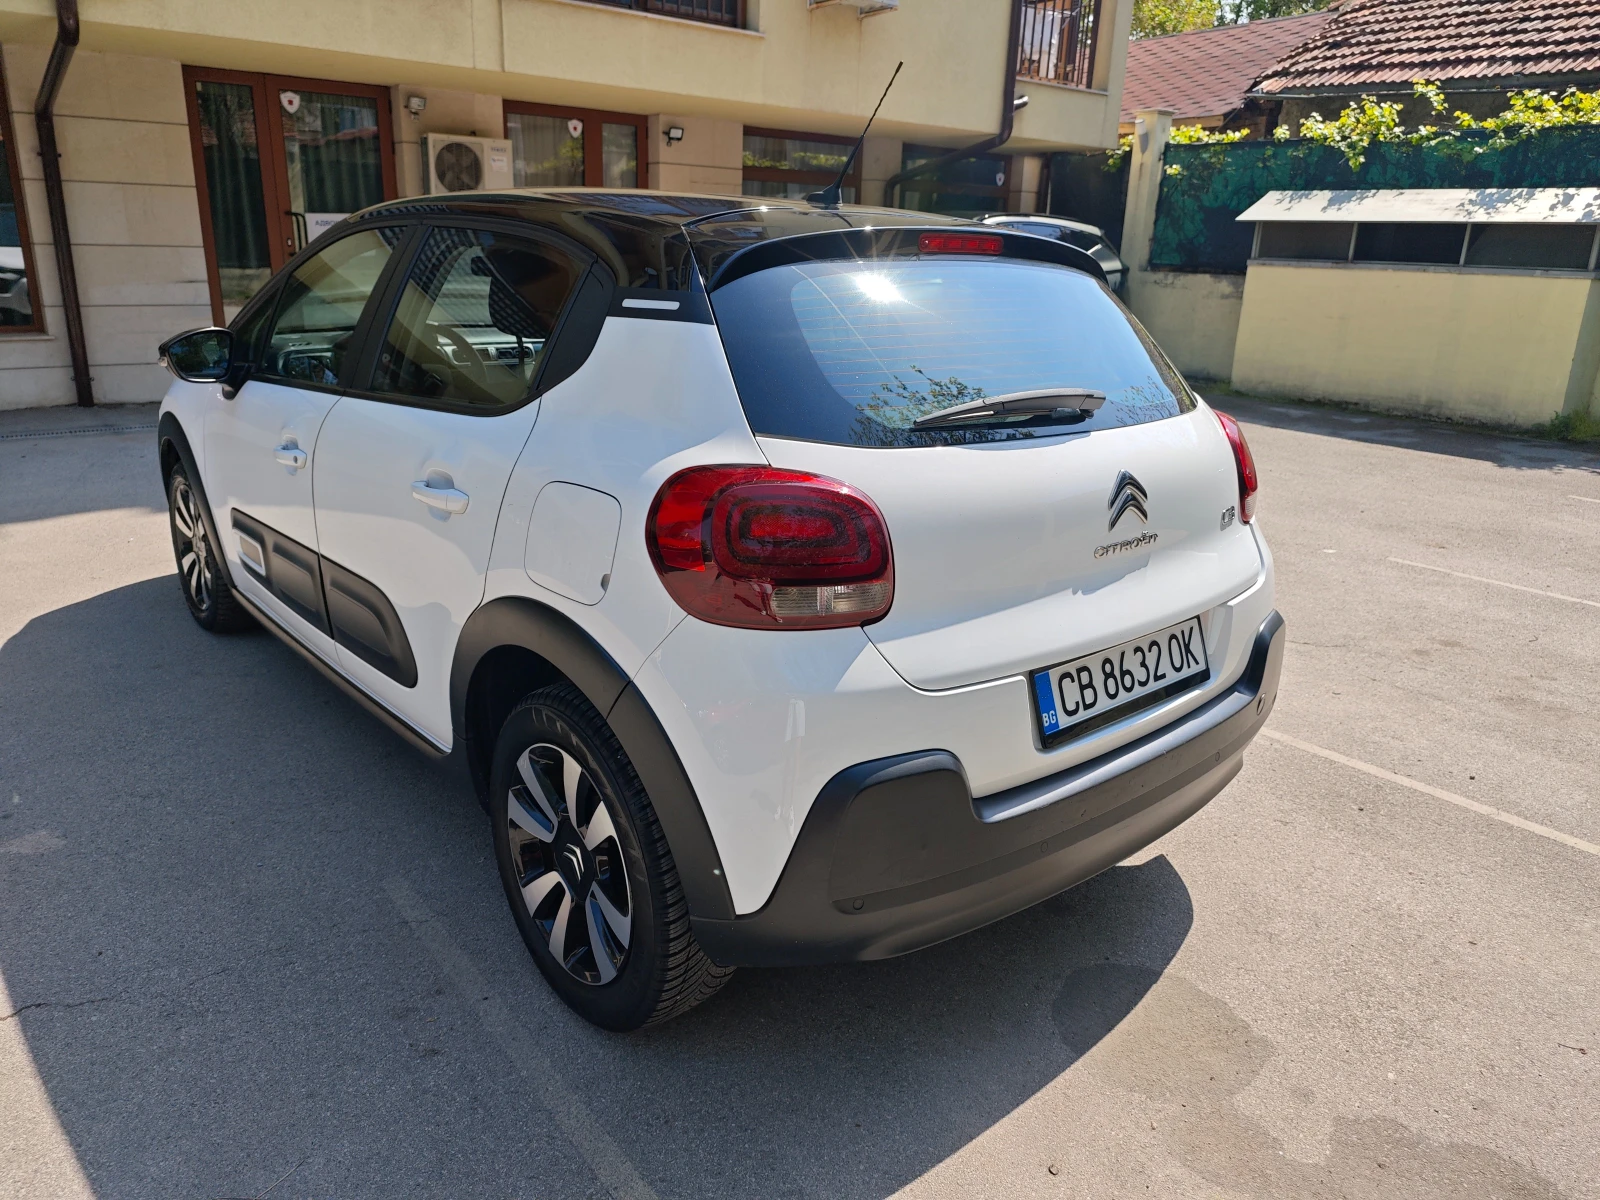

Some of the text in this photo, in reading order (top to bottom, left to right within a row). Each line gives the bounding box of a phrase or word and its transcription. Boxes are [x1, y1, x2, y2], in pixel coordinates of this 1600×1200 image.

[1058, 626, 1200, 718] CB 8632 OK
[1042, 710, 1057, 727] BG
